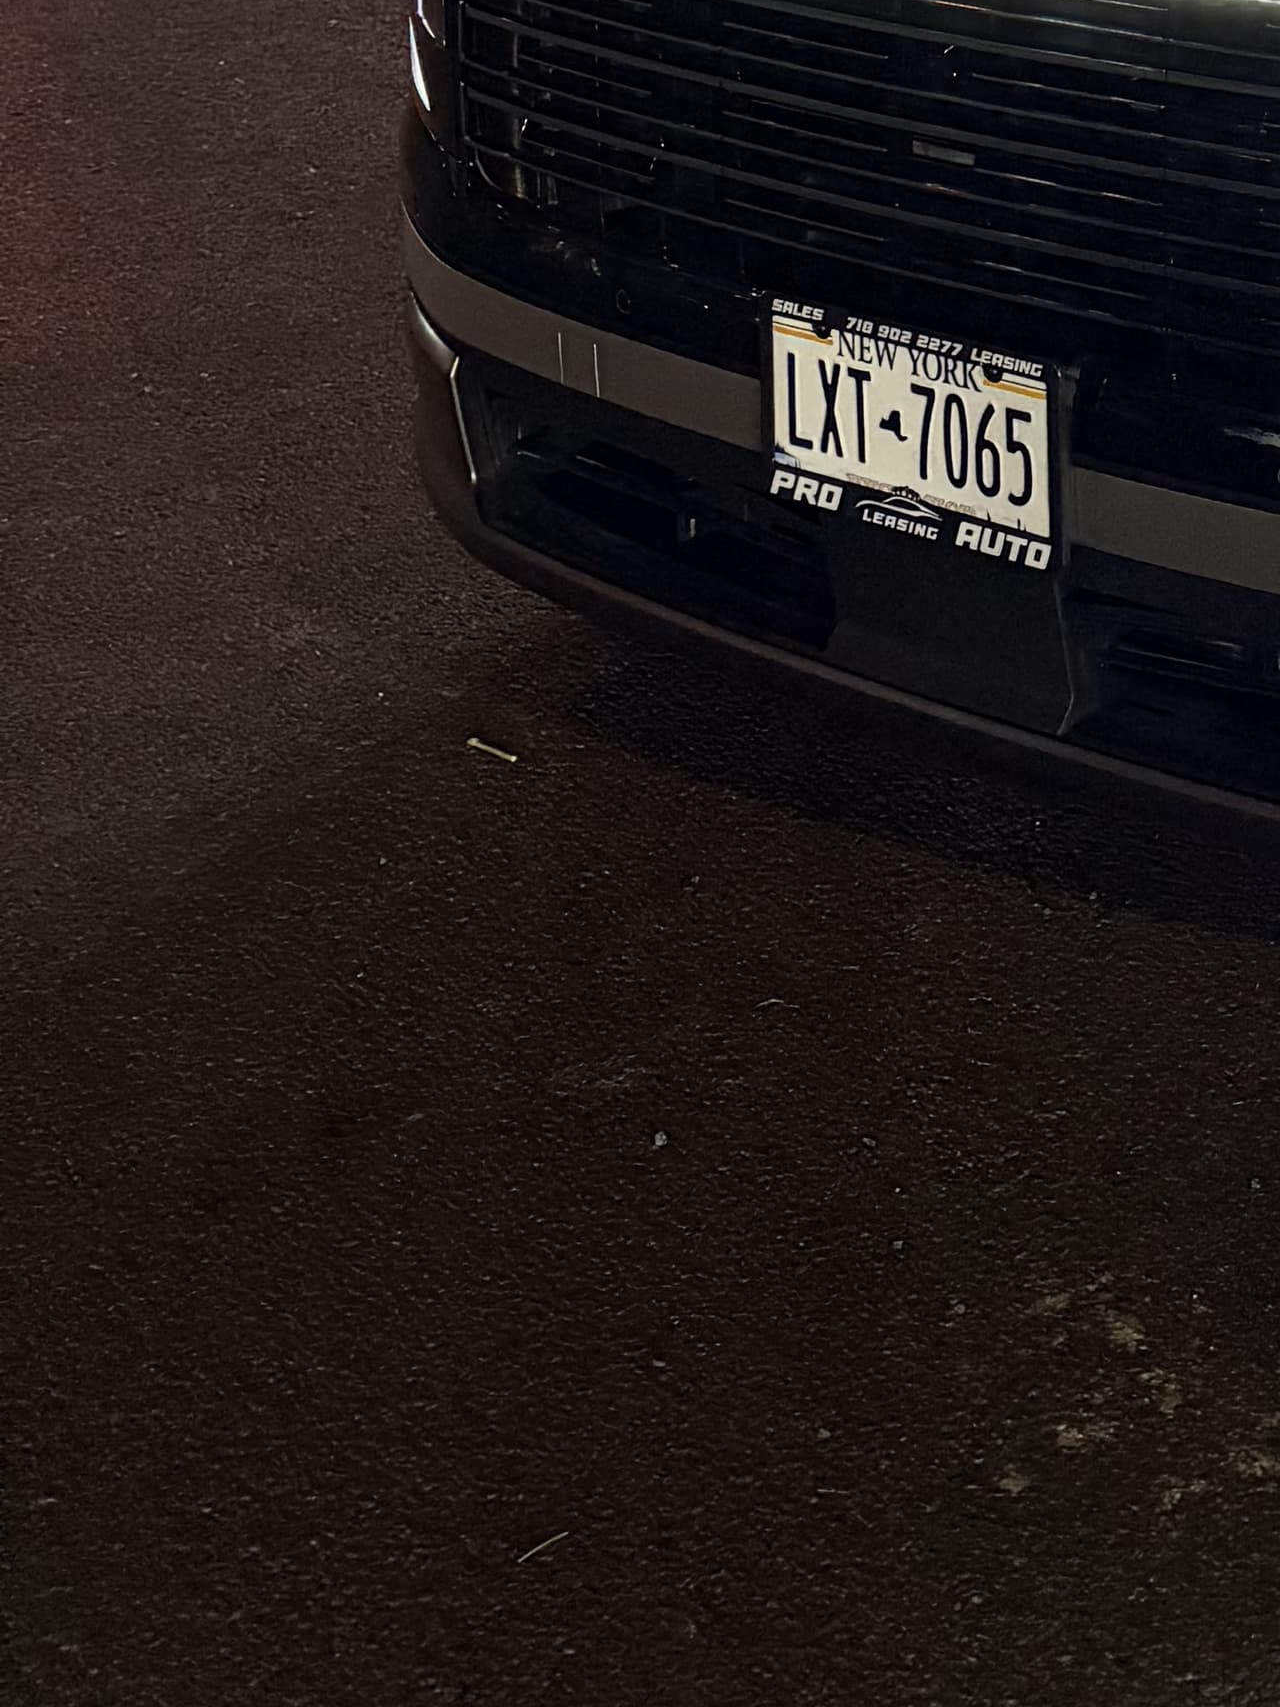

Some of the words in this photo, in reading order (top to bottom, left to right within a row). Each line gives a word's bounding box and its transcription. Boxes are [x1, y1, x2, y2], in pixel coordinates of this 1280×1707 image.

[771, 298, 825, 321] SALES
[846, 316, 874, 334] 718
[879, 324, 912, 344] 902
[917, 334, 963, 356] 2277
[970, 347, 1044, 378] LEASING
[837, 332, 900, 372] NEW
[901, 347, 984, 393] YORK
[769, 469, 844, 512] PRO
[862, 508, 940, 541] LEASING
[955, 521, 1052, 571] AUTO
